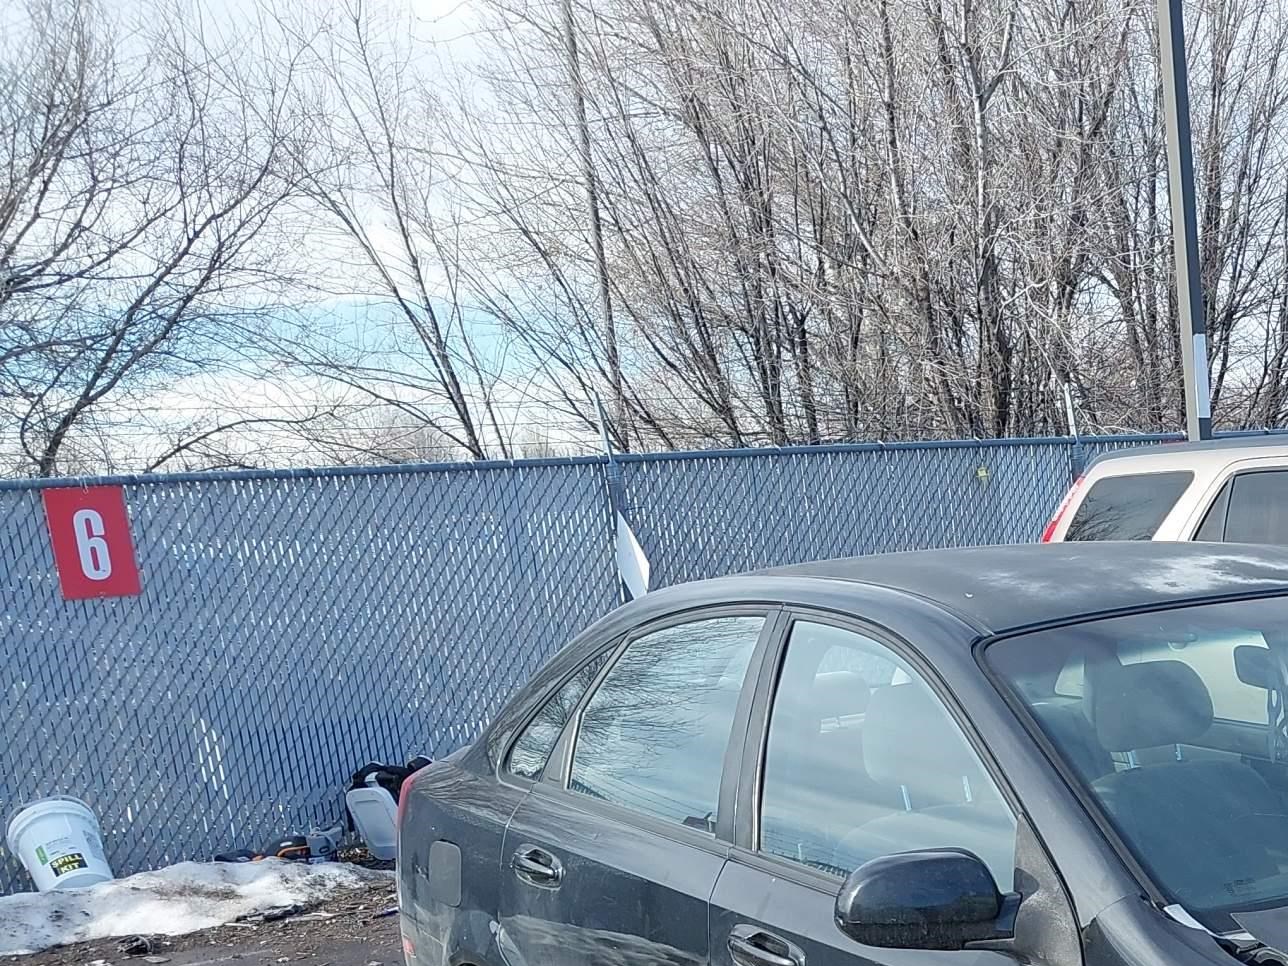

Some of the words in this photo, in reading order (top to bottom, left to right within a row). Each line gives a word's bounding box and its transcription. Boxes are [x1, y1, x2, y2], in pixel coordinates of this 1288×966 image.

[73, 509, 112, 580] 6
[52, 853, 82, 868] SPILL
[60, 862, 81, 874] KIT
